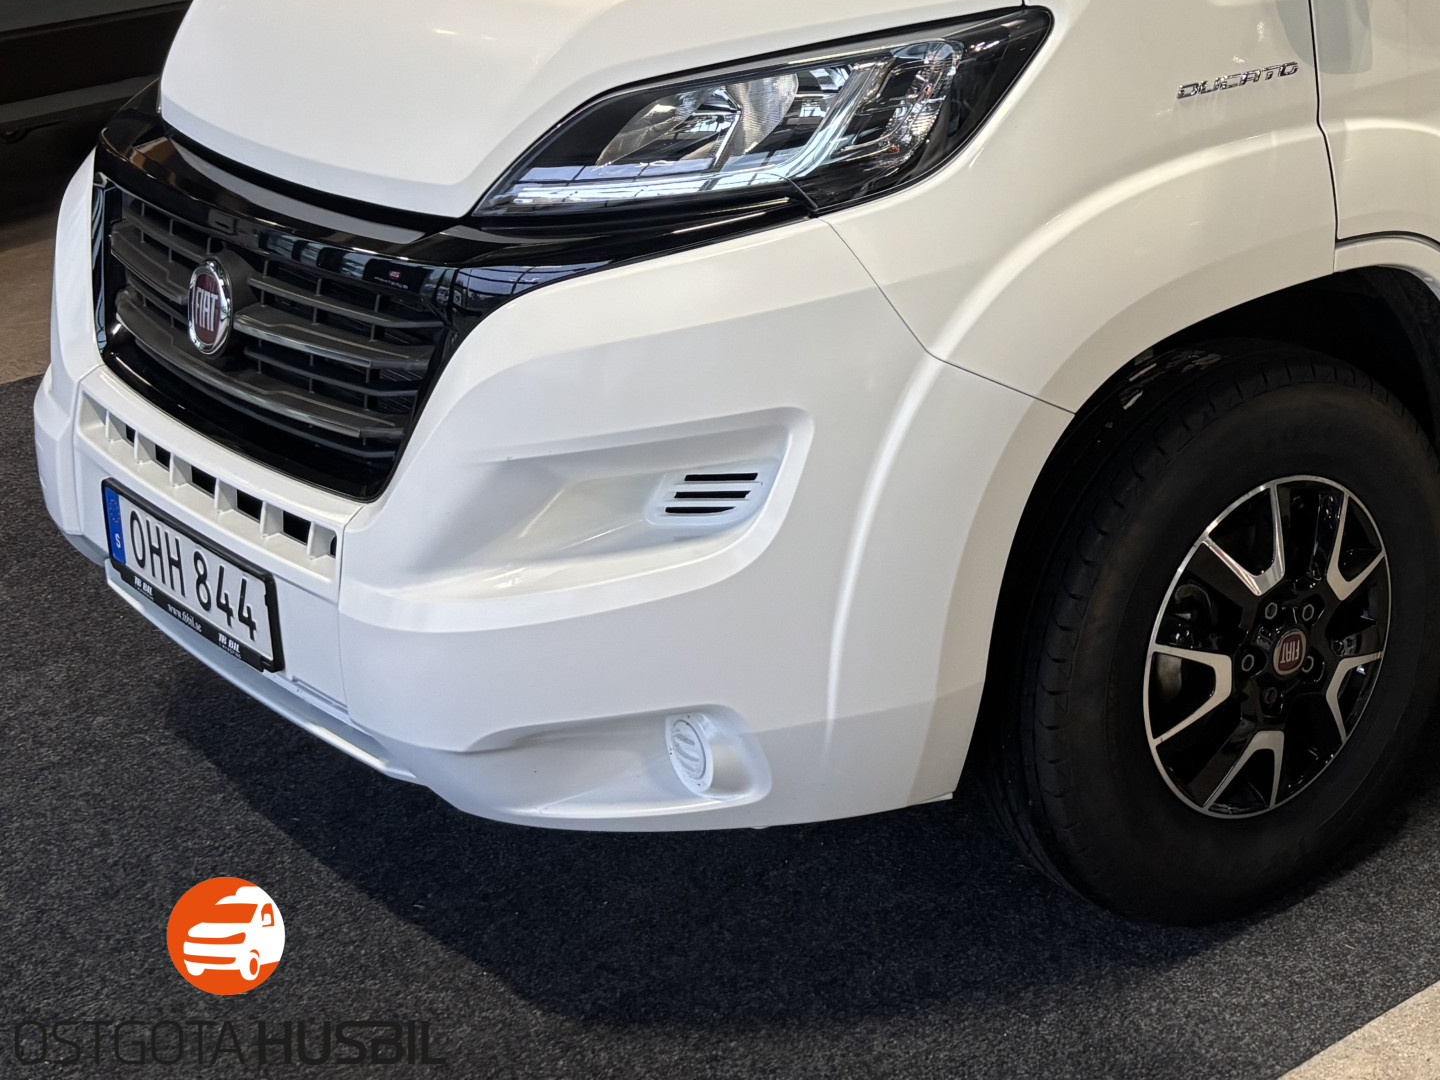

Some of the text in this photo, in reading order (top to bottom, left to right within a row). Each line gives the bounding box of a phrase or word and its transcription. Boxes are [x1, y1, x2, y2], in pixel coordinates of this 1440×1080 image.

[1177, 62, 1298, 99] DUCATO
[194, 286, 219, 332] FIAT
[114, 533, 121, 549] S
[130, 510, 257, 642] OHH 844
[1280, 639, 1300, 664] FIAT
